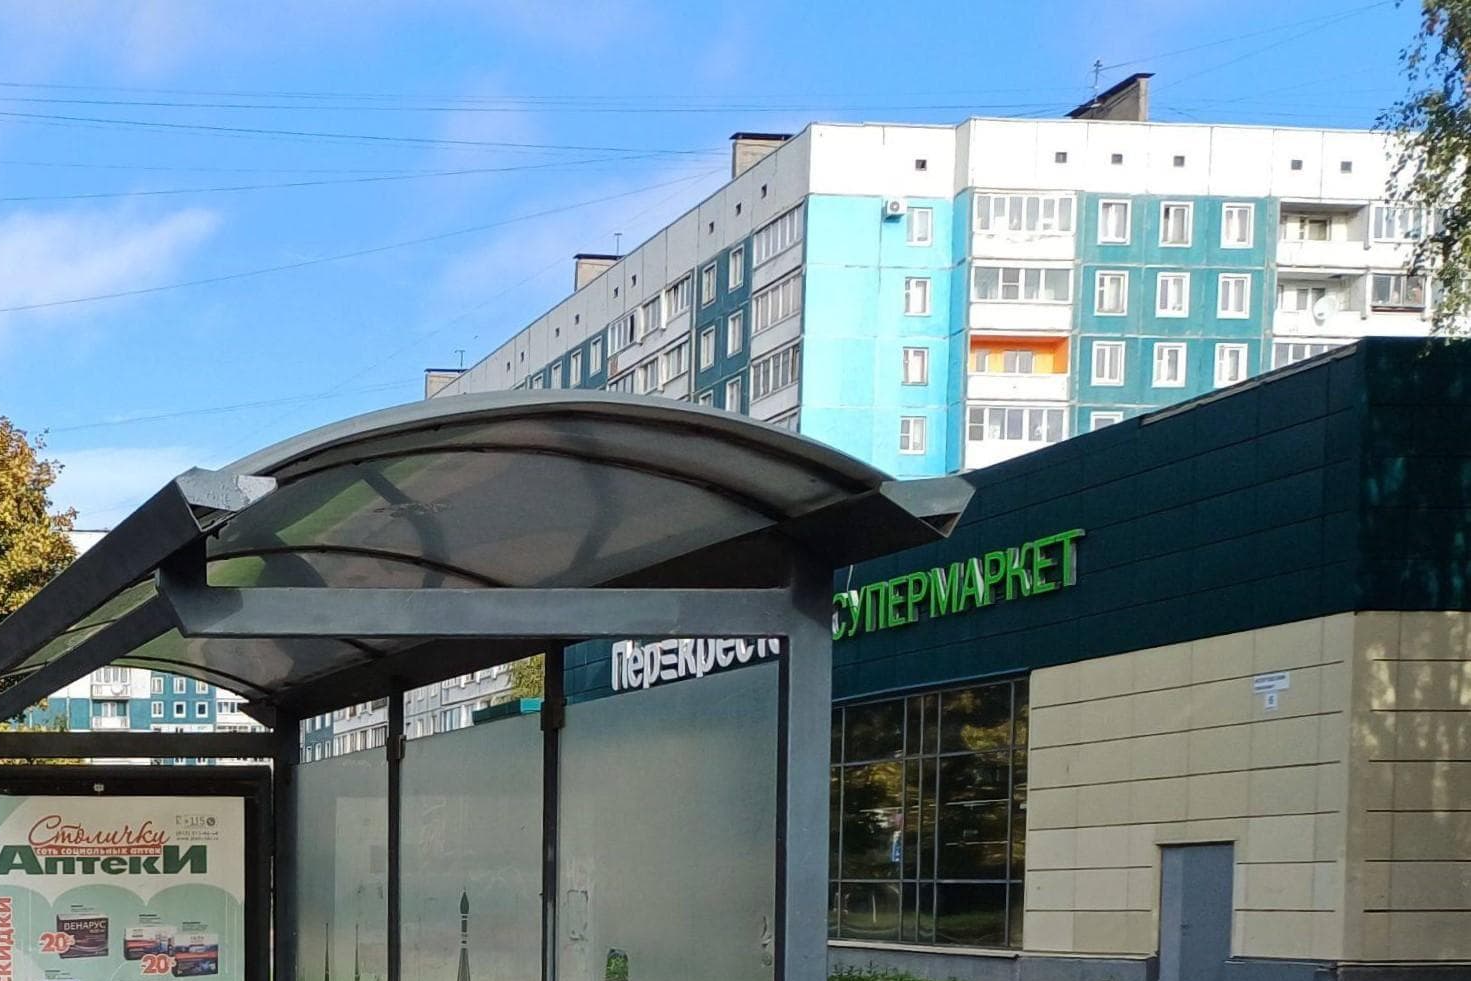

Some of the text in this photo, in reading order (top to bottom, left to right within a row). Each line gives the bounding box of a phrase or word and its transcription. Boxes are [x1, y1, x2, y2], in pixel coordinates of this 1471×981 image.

[832, 528, 1085, 640] СУПЕРМАРКЕТ
[28, 815, 170, 845] Столички
[61, 848, 128, 856] социальных
